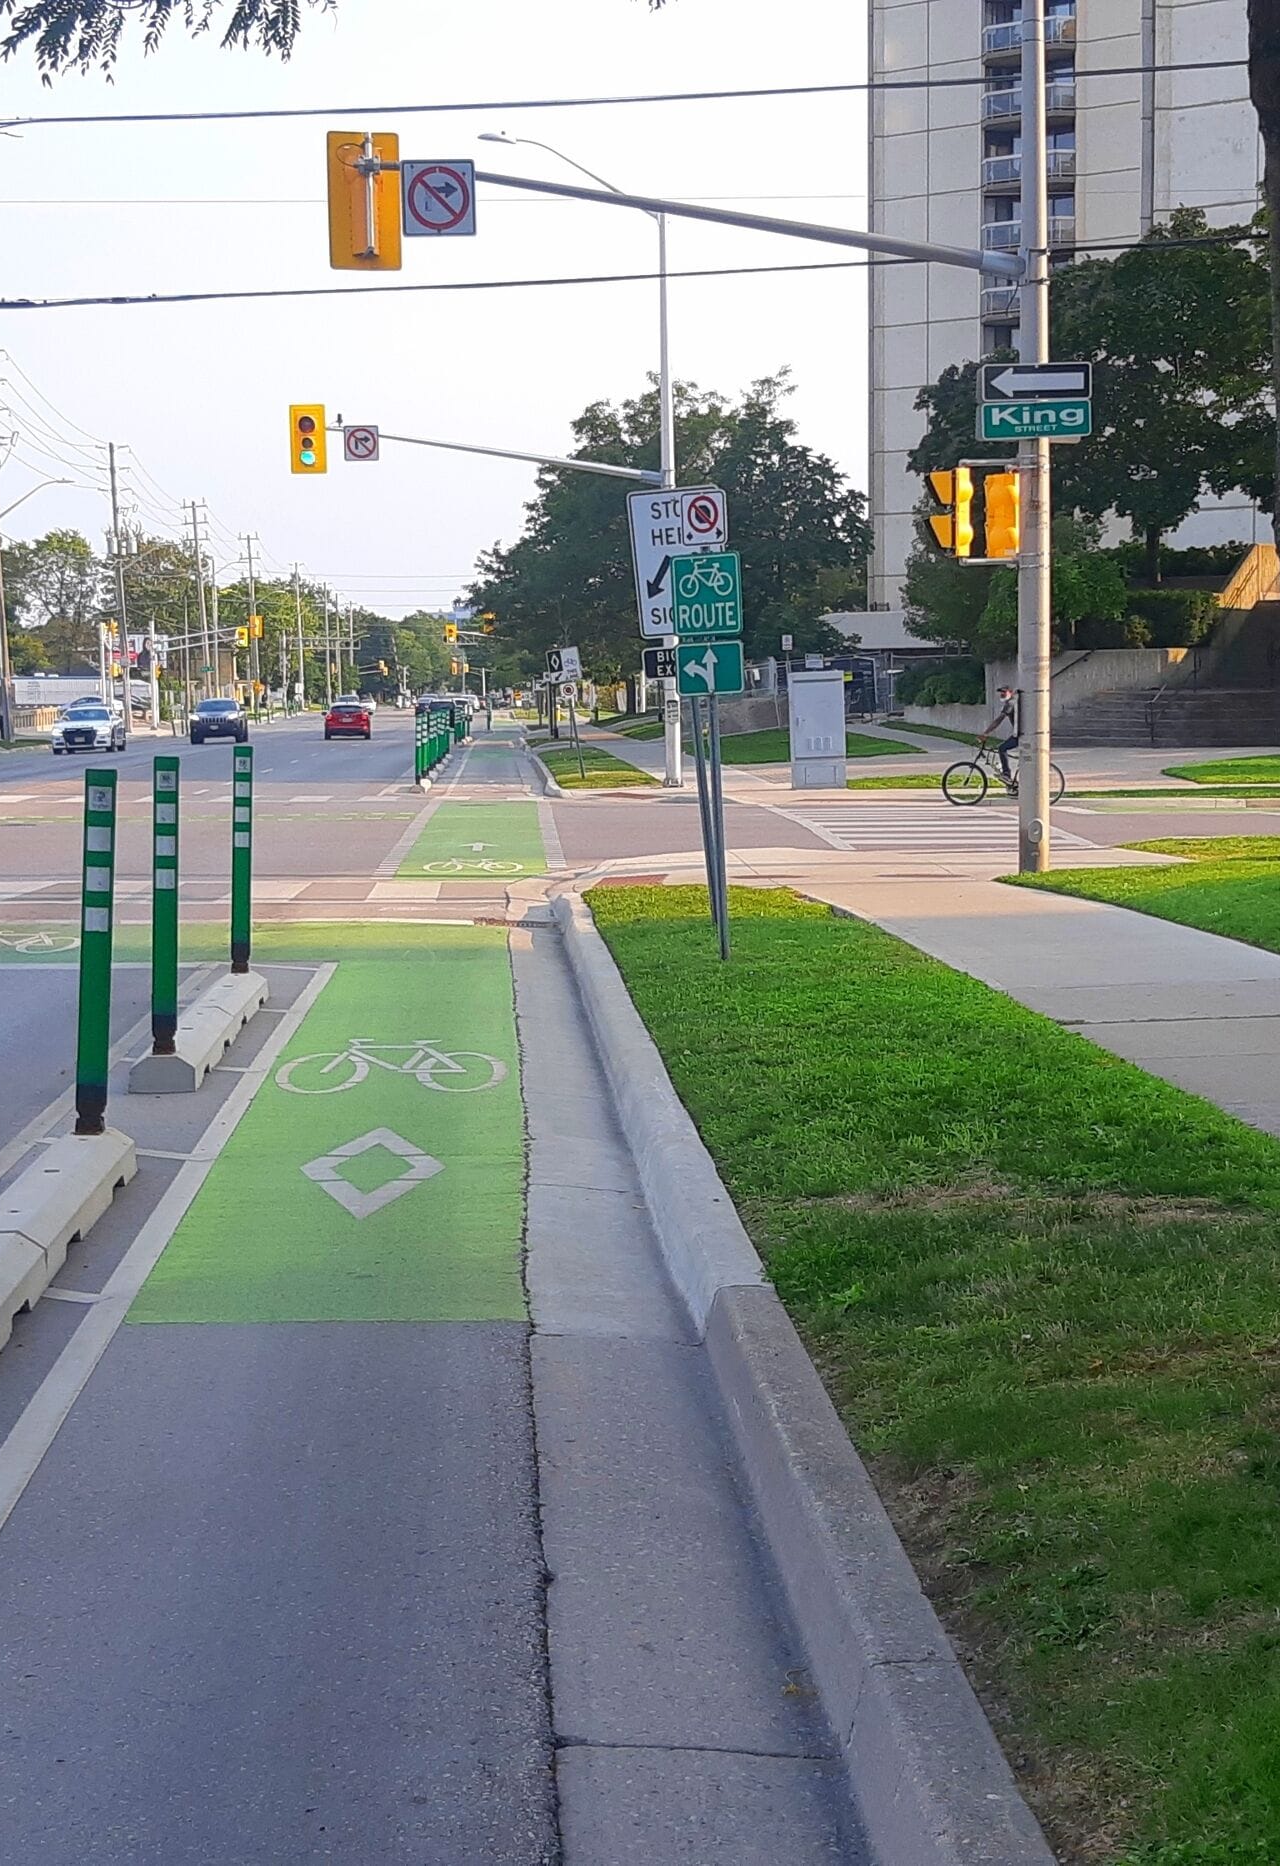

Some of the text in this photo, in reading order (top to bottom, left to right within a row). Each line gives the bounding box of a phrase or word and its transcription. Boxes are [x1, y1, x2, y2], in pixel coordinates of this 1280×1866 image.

[991, 406, 1084, 426] King
[1014, 424, 1058, 433] STREET
[650, 500, 681, 520] STO
[679, 602, 737, 629] ROUTE
